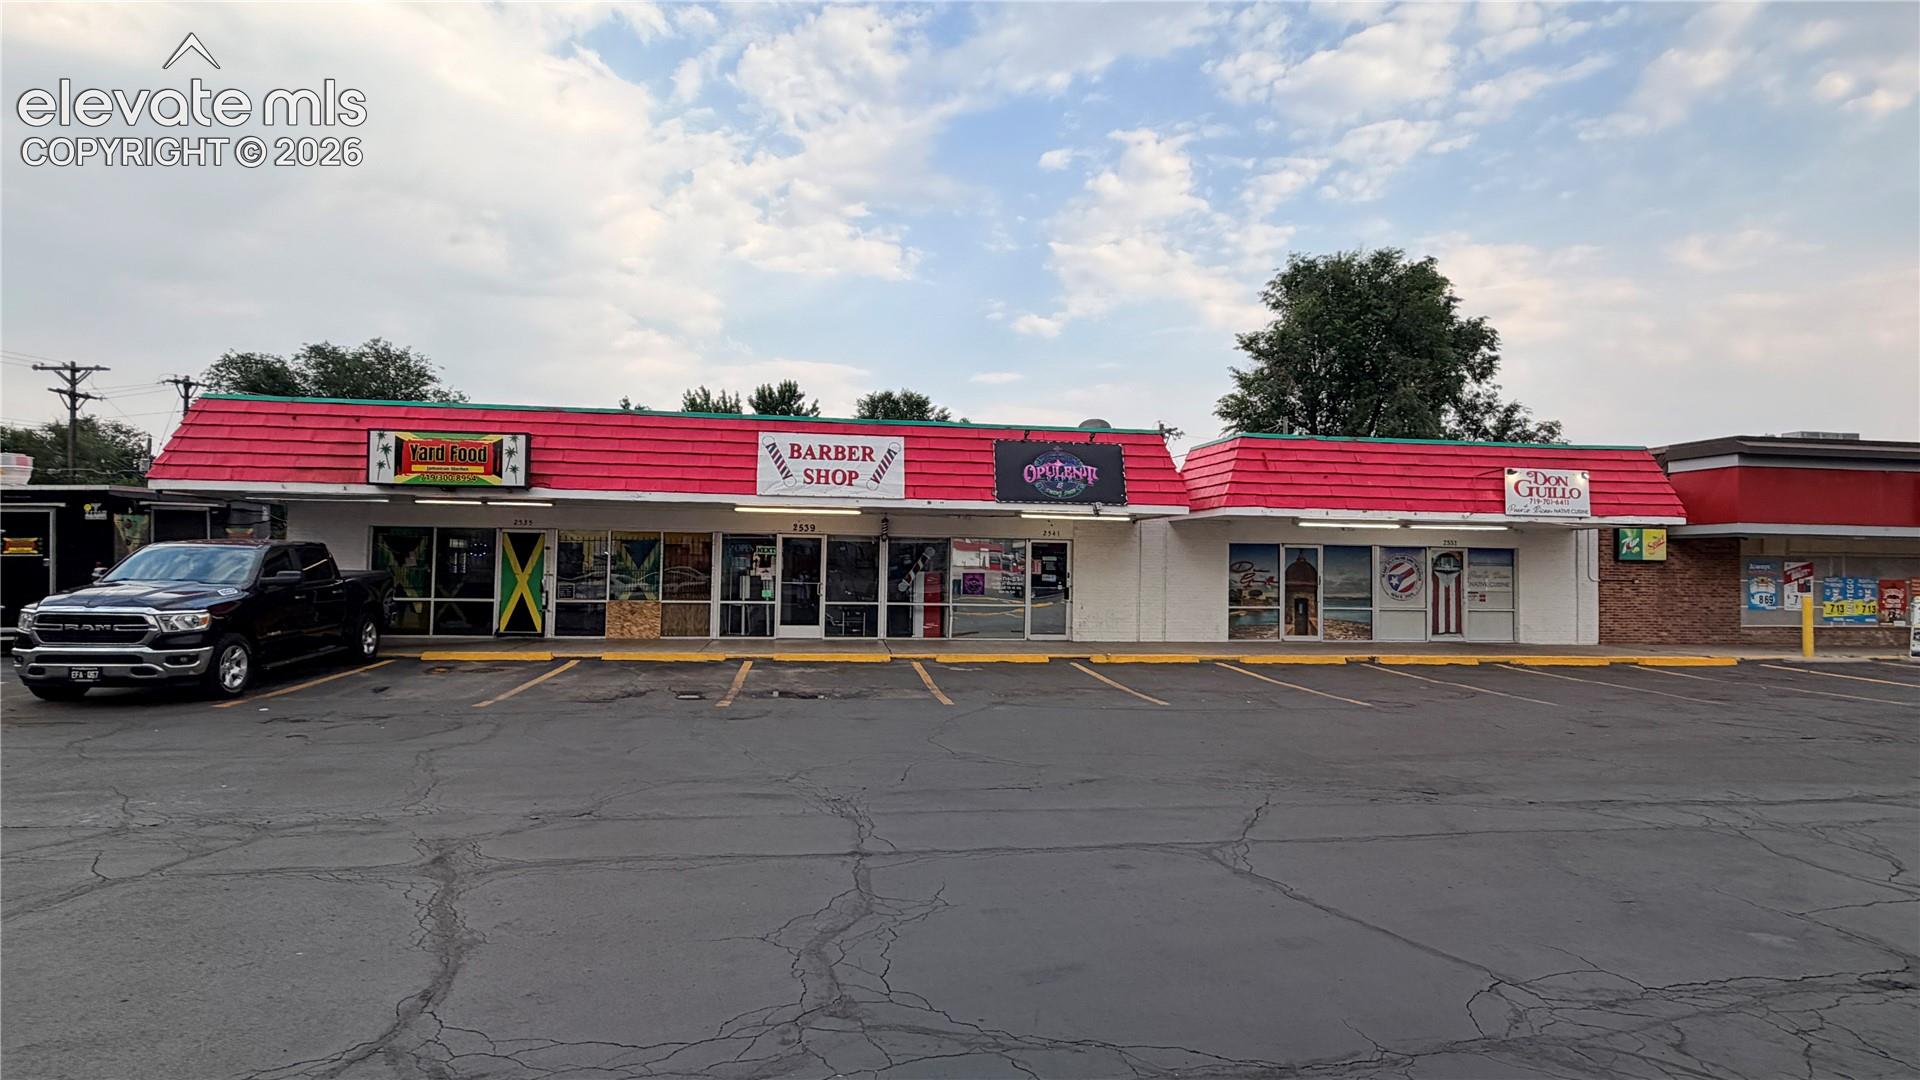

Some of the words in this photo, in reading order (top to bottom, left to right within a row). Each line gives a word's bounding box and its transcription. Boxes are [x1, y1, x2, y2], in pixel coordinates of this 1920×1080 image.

[409, 443, 446, 462] Yard
[449, 444, 488, 463] Food
[789, 443, 875, 461] BARBER
[803, 468, 859, 486] SHOP
[1526, 470, 1569, 487] DON
[1513, 479, 1582, 499] GUILLO
[793, 523, 816, 532] 2539
[64, 623, 112, 631] RAM
